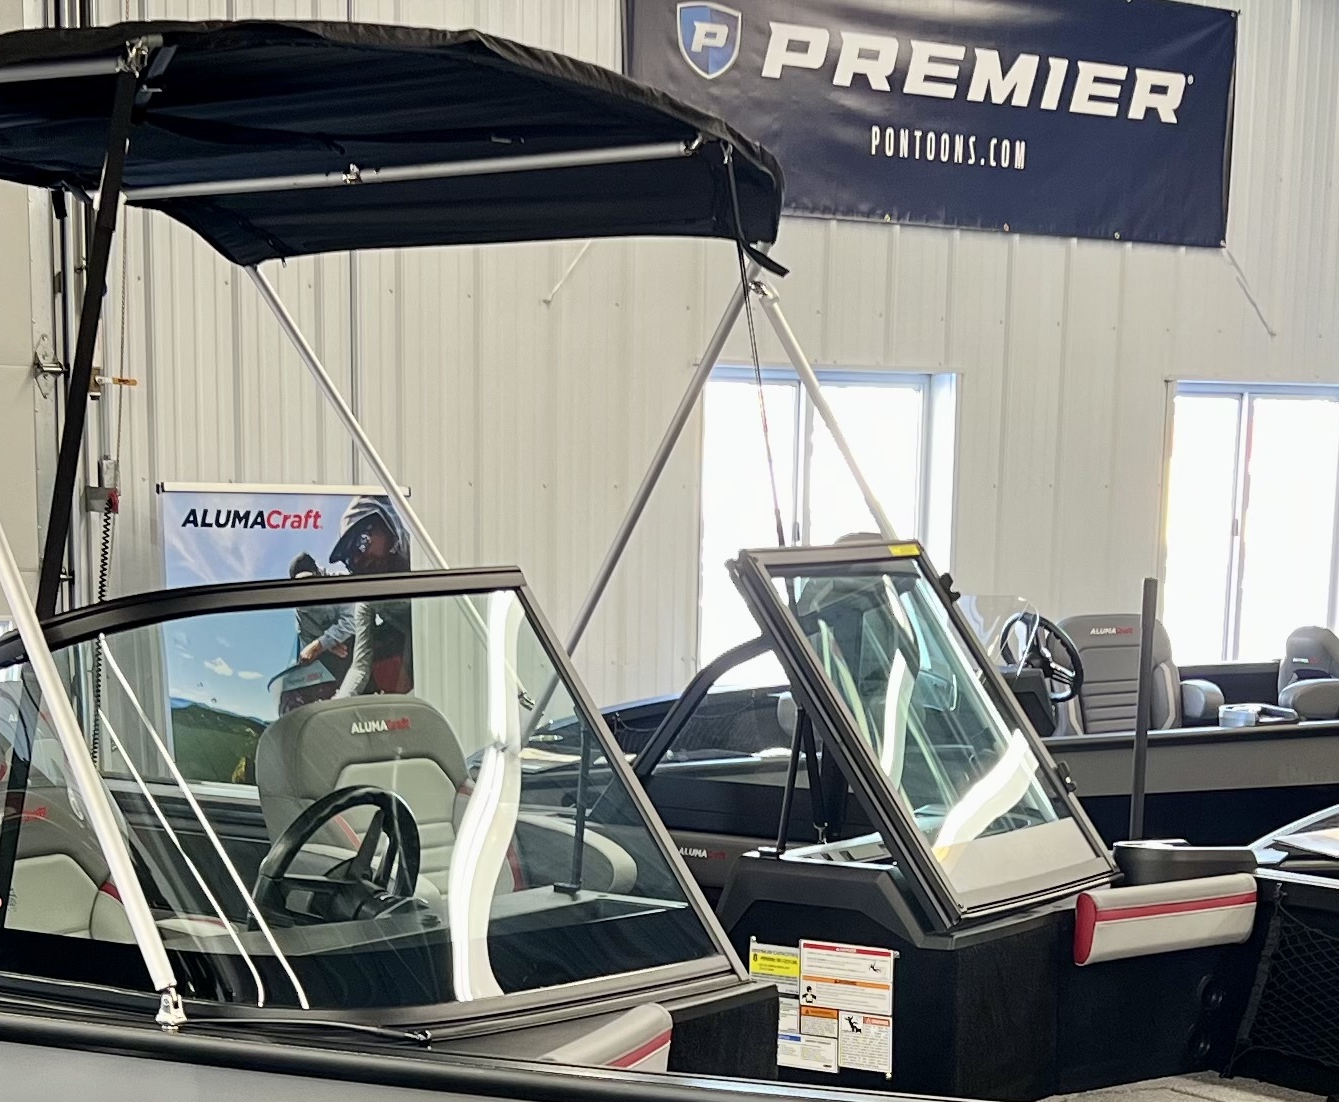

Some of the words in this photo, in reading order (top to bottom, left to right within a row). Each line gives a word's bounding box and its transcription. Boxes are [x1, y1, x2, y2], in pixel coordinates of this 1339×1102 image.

[761, 22, 1187, 124] PREMIER
[870, 125, 1028, 171] PONTOONS.COM
[181, 508, 322, 530] ALUMACraft
